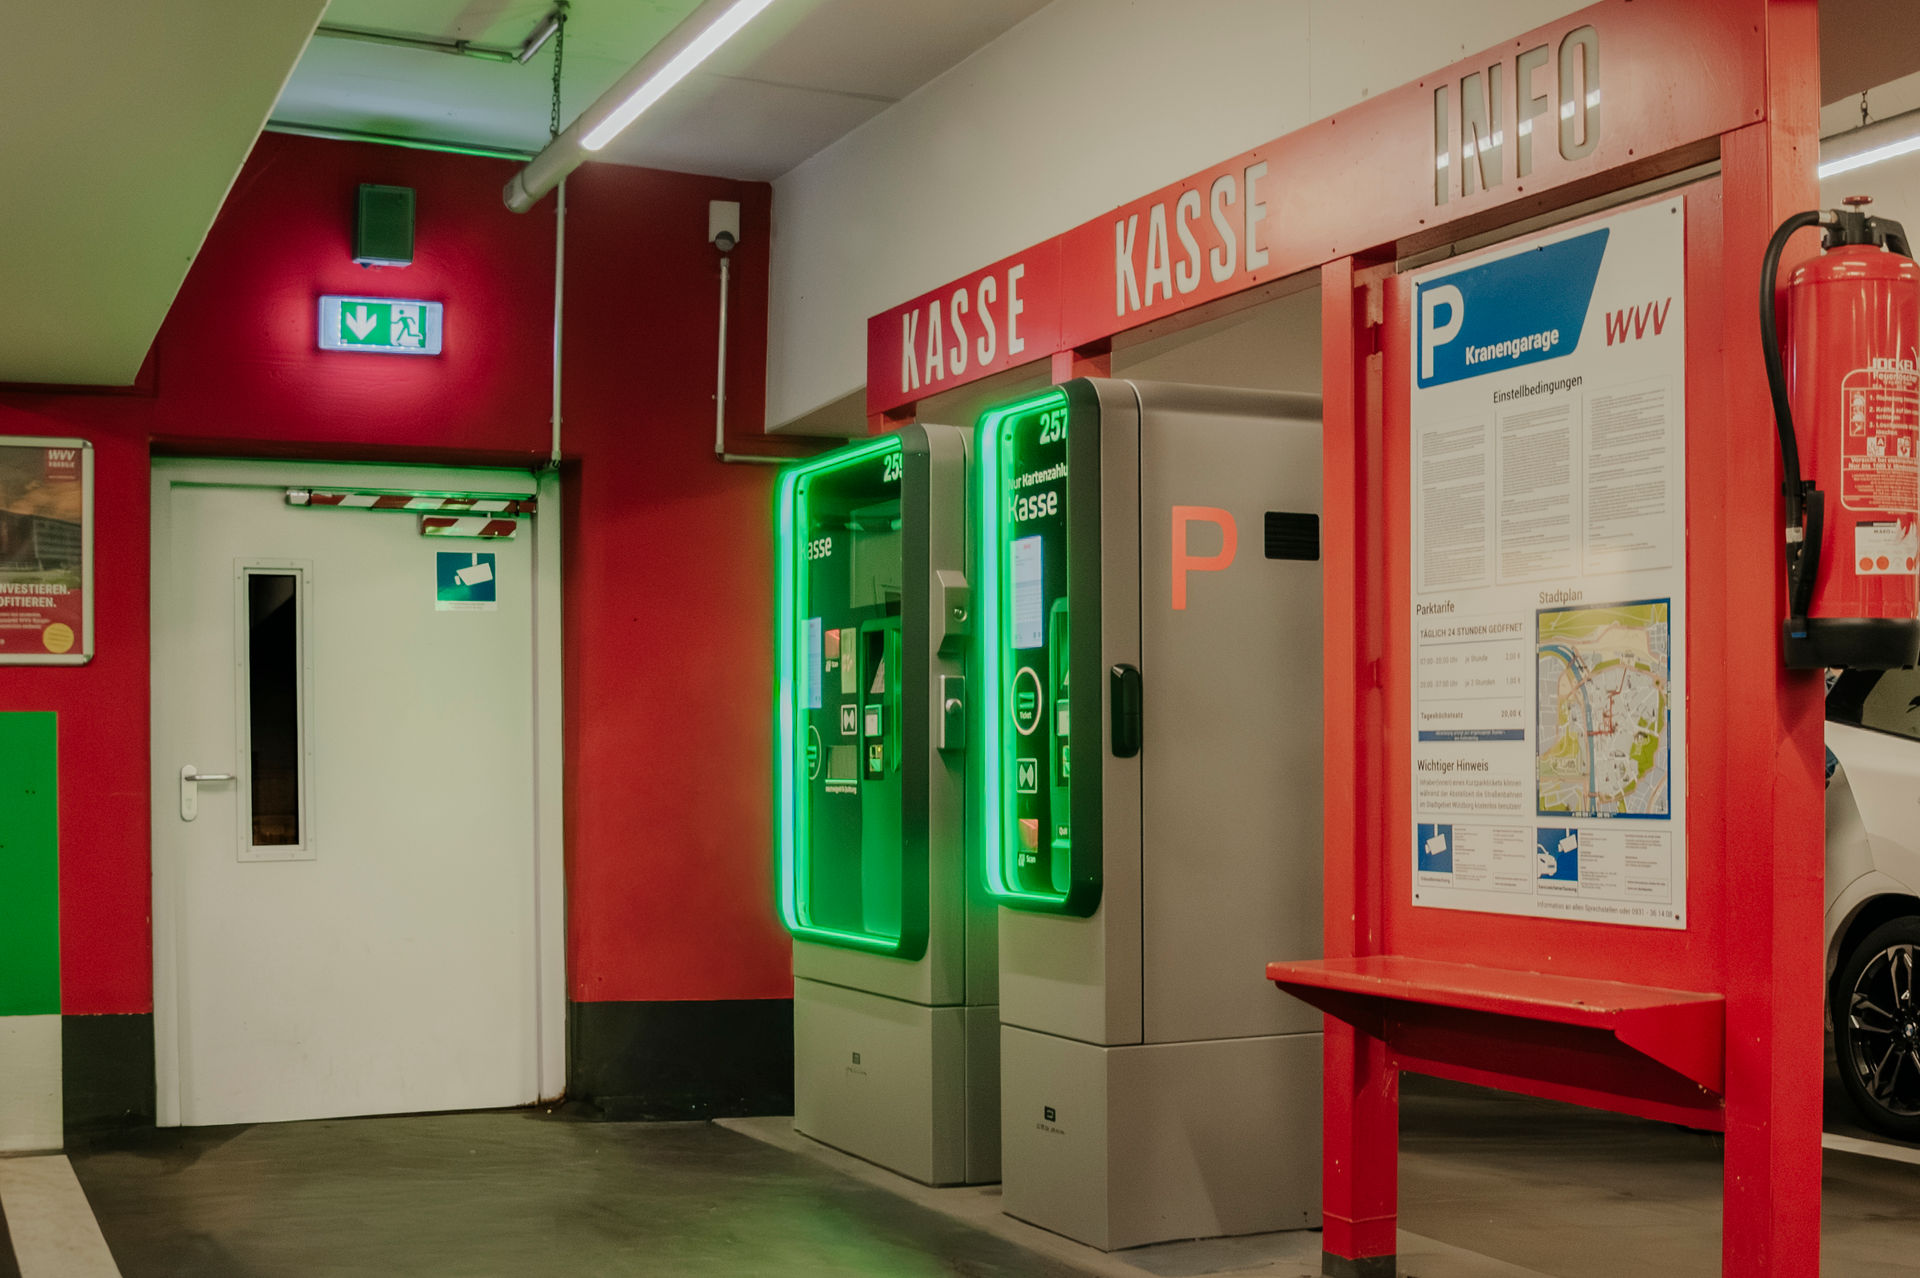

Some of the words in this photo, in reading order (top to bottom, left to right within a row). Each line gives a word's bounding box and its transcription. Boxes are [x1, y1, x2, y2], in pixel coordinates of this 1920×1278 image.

[1433, 23, 1600, 207] INFO
[1114, 159, 1271, 318] KASSE
[900, 263, 1026, 395] KASSE
[1421, 283, 1465, 380] P
[1605, 296, 1672, 347] WVV
[1465, 327, 1560, 367] Kranengarage
[1492, 374, 1584, 404] Einstellbedingungen
[1039, 407, 1068, 446] 257
[1008, 490, 1058, 523] Kasse
[1171, 504, 1238, 611] P
[1416, 600, 1455, 616] Parktarife
[1538, 588, 1583, 606] Stadtplan
[1420, 627, 1446, 639] TÄGLICH
[1447, 627, 1456, 637] 24
[1456, 625, 1487, 637] STUNDEN
[1488, 621, 1523, 634] GEÖFFNET
[1417, 758, 1454, 774] Wichtiger
[1456, 758, 1489, 772] Hinweis
